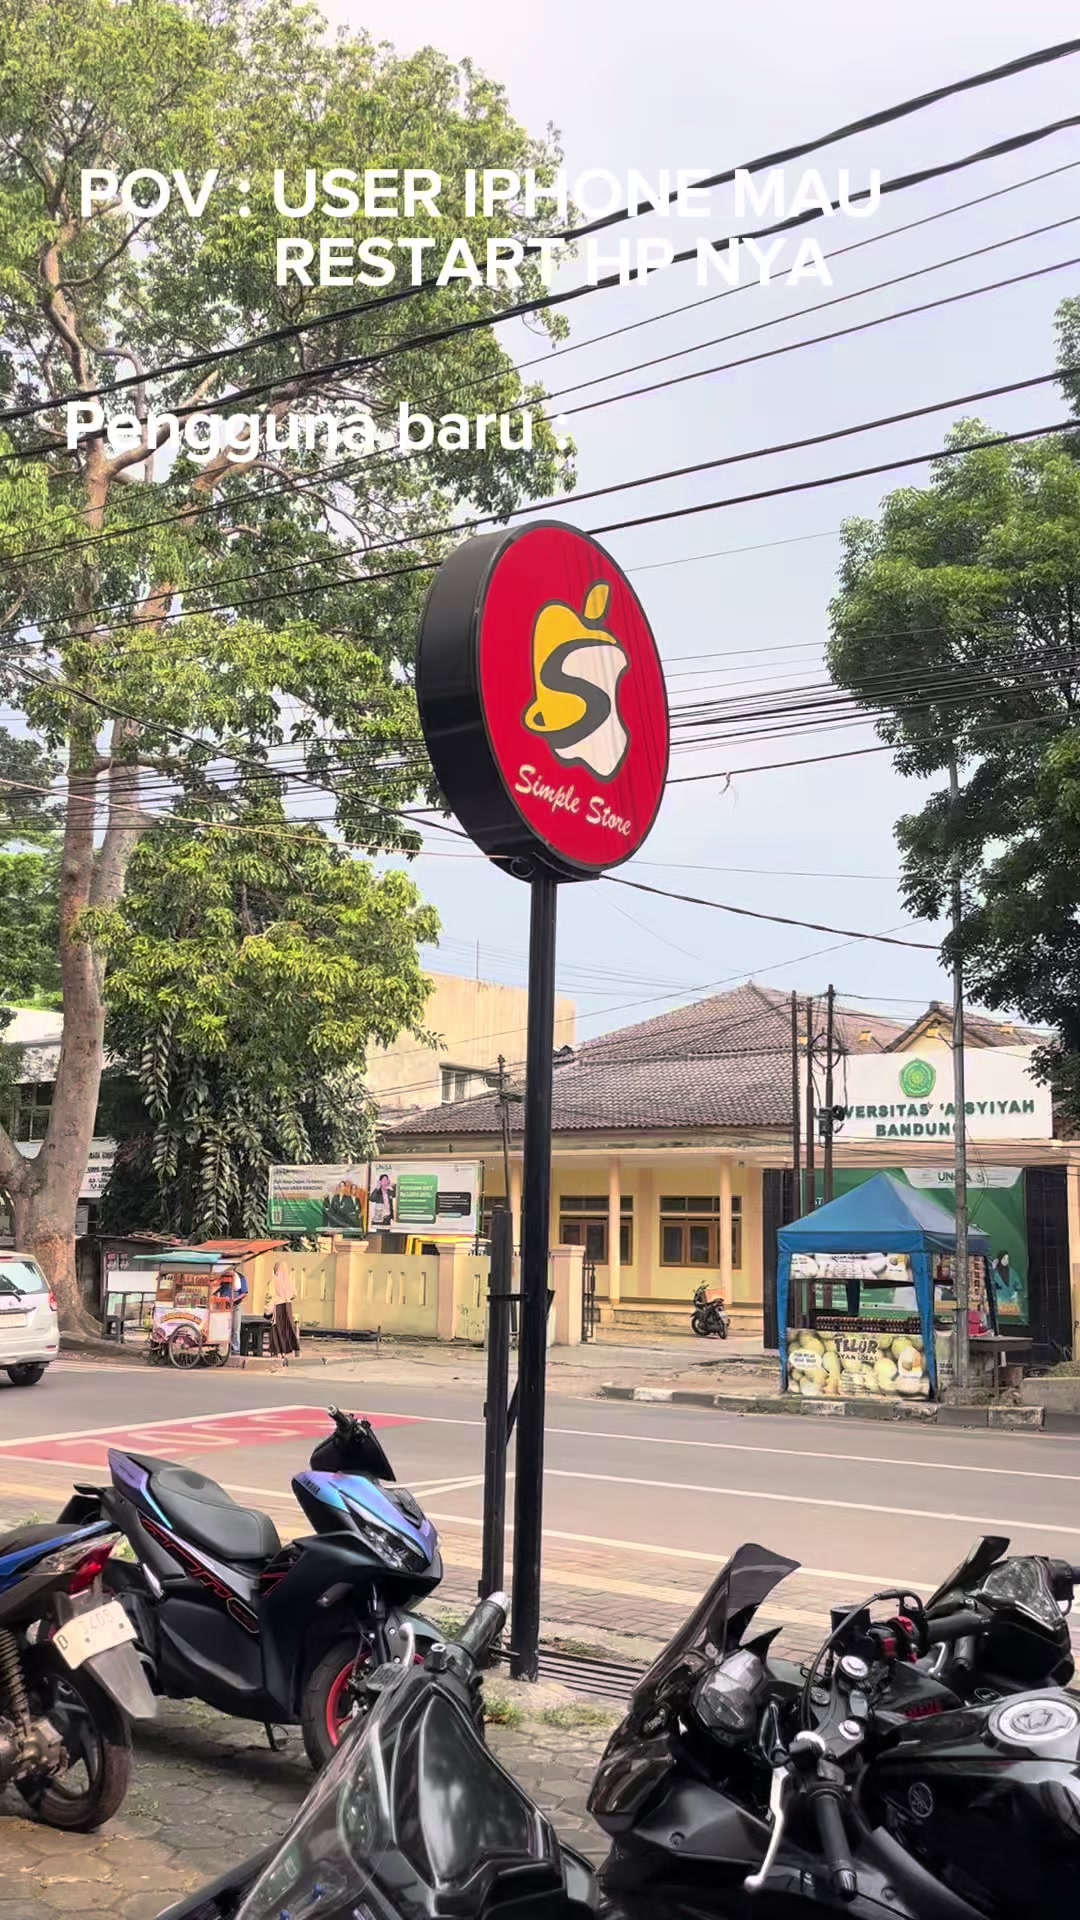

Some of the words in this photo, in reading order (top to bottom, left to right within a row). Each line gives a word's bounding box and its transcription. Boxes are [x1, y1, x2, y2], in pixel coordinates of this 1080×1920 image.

[515, 764, 580, 813] Simple
[586, 796, 631, 836] Store
[938, 1172, 971, 1181] UNA
[834, 1337, 878, 1354] TELUR
